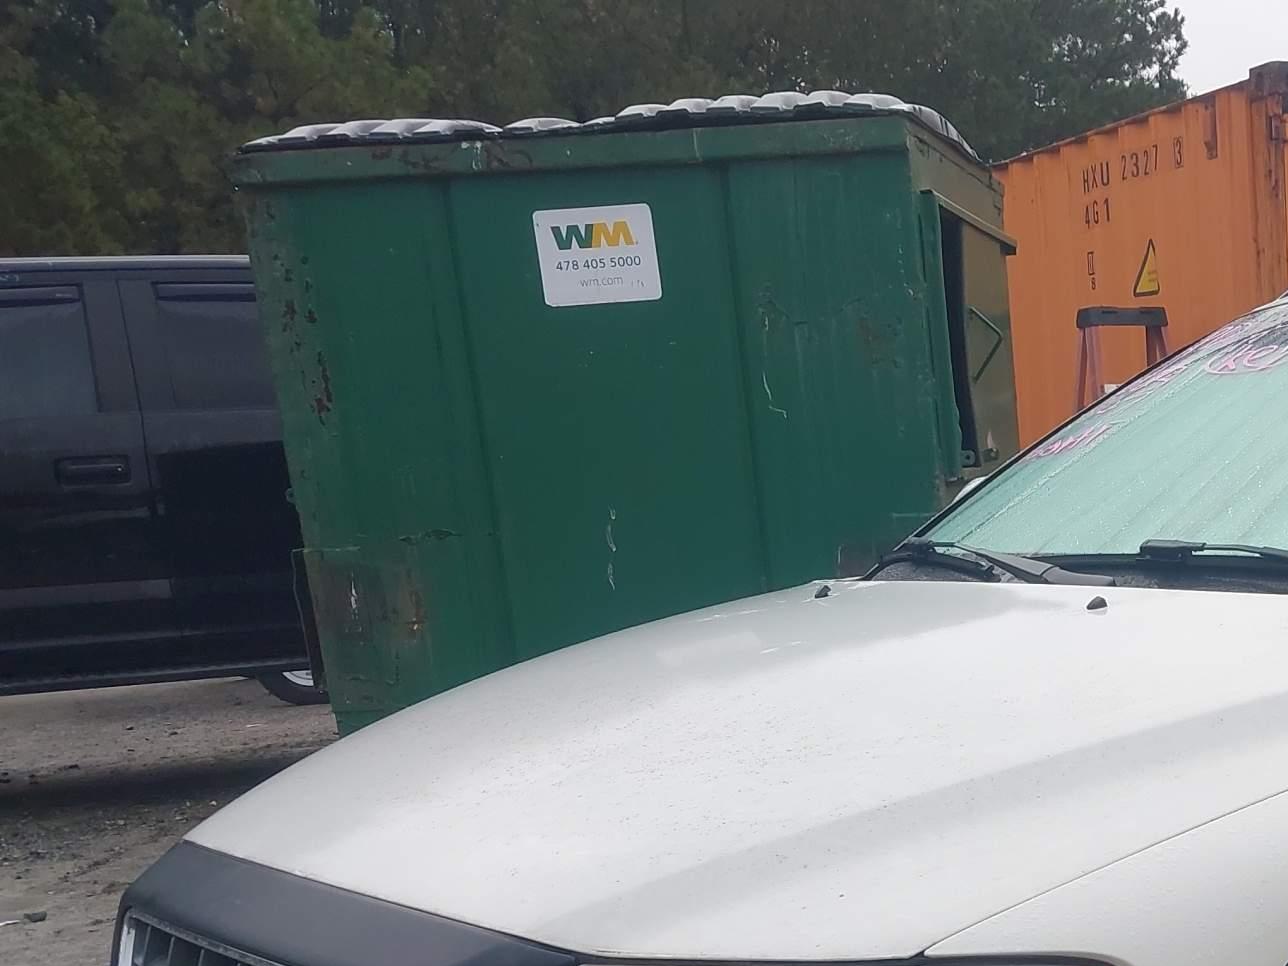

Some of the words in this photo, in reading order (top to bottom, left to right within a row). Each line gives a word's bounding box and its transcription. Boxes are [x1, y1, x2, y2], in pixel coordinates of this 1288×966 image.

[551, 220, 635, 251] WM
[556, 260, 580, 272] 478
[583, 258, 606, 271] 405
[610, 255, 642, 268] 5000
[580, 275, 624, 288] wm.com
